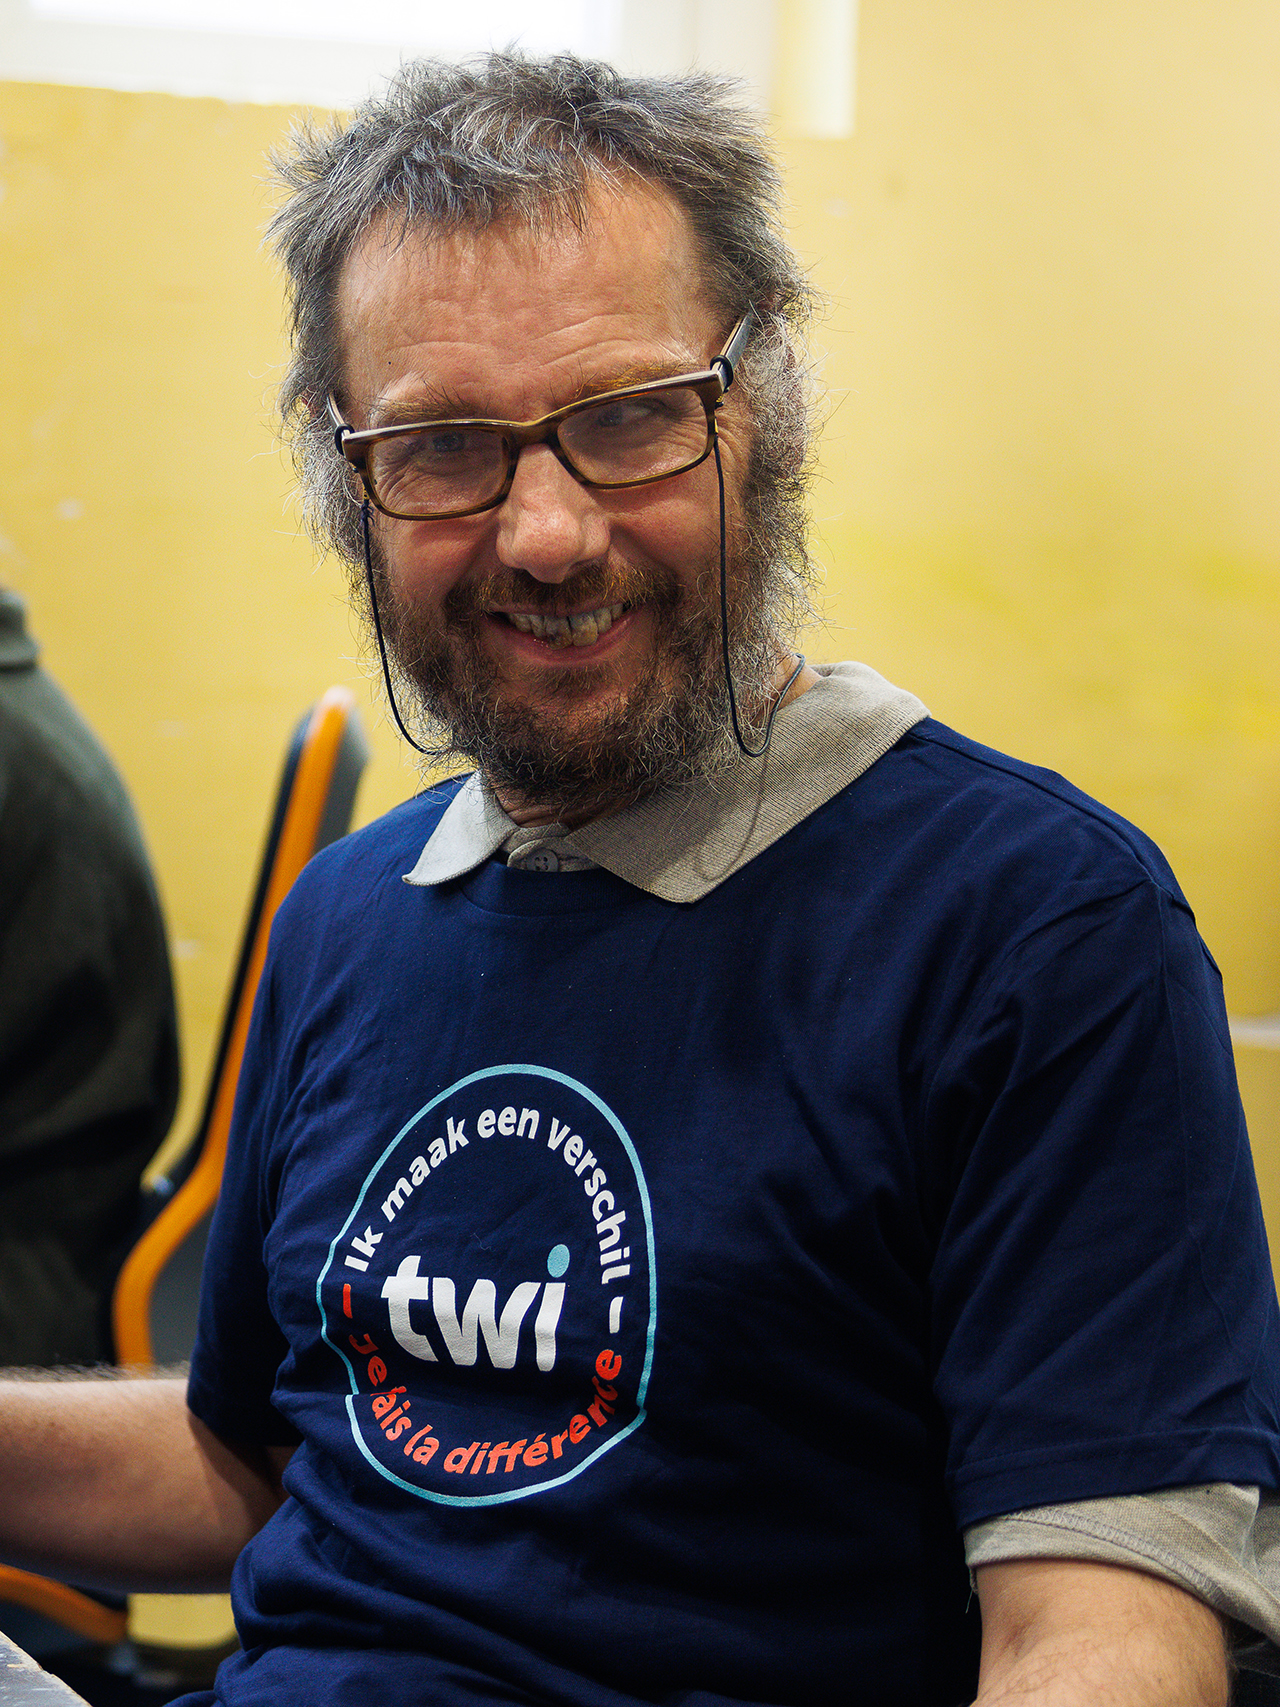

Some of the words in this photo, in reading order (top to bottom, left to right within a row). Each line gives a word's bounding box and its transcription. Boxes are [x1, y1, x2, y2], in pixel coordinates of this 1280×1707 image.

[344, 1226, 383, 1273] Ik
[380, 1117, 470, 1223] maak
[477, 1107, 540, 1140] een
[548, 1118, 631, 1285] verschil
[380, 1243, 571, 1372] twi
[348, 1333, 388, 1387] Je
[403, 1424, 440, 1466] la
[443, 1349, 623, 1475] différence
